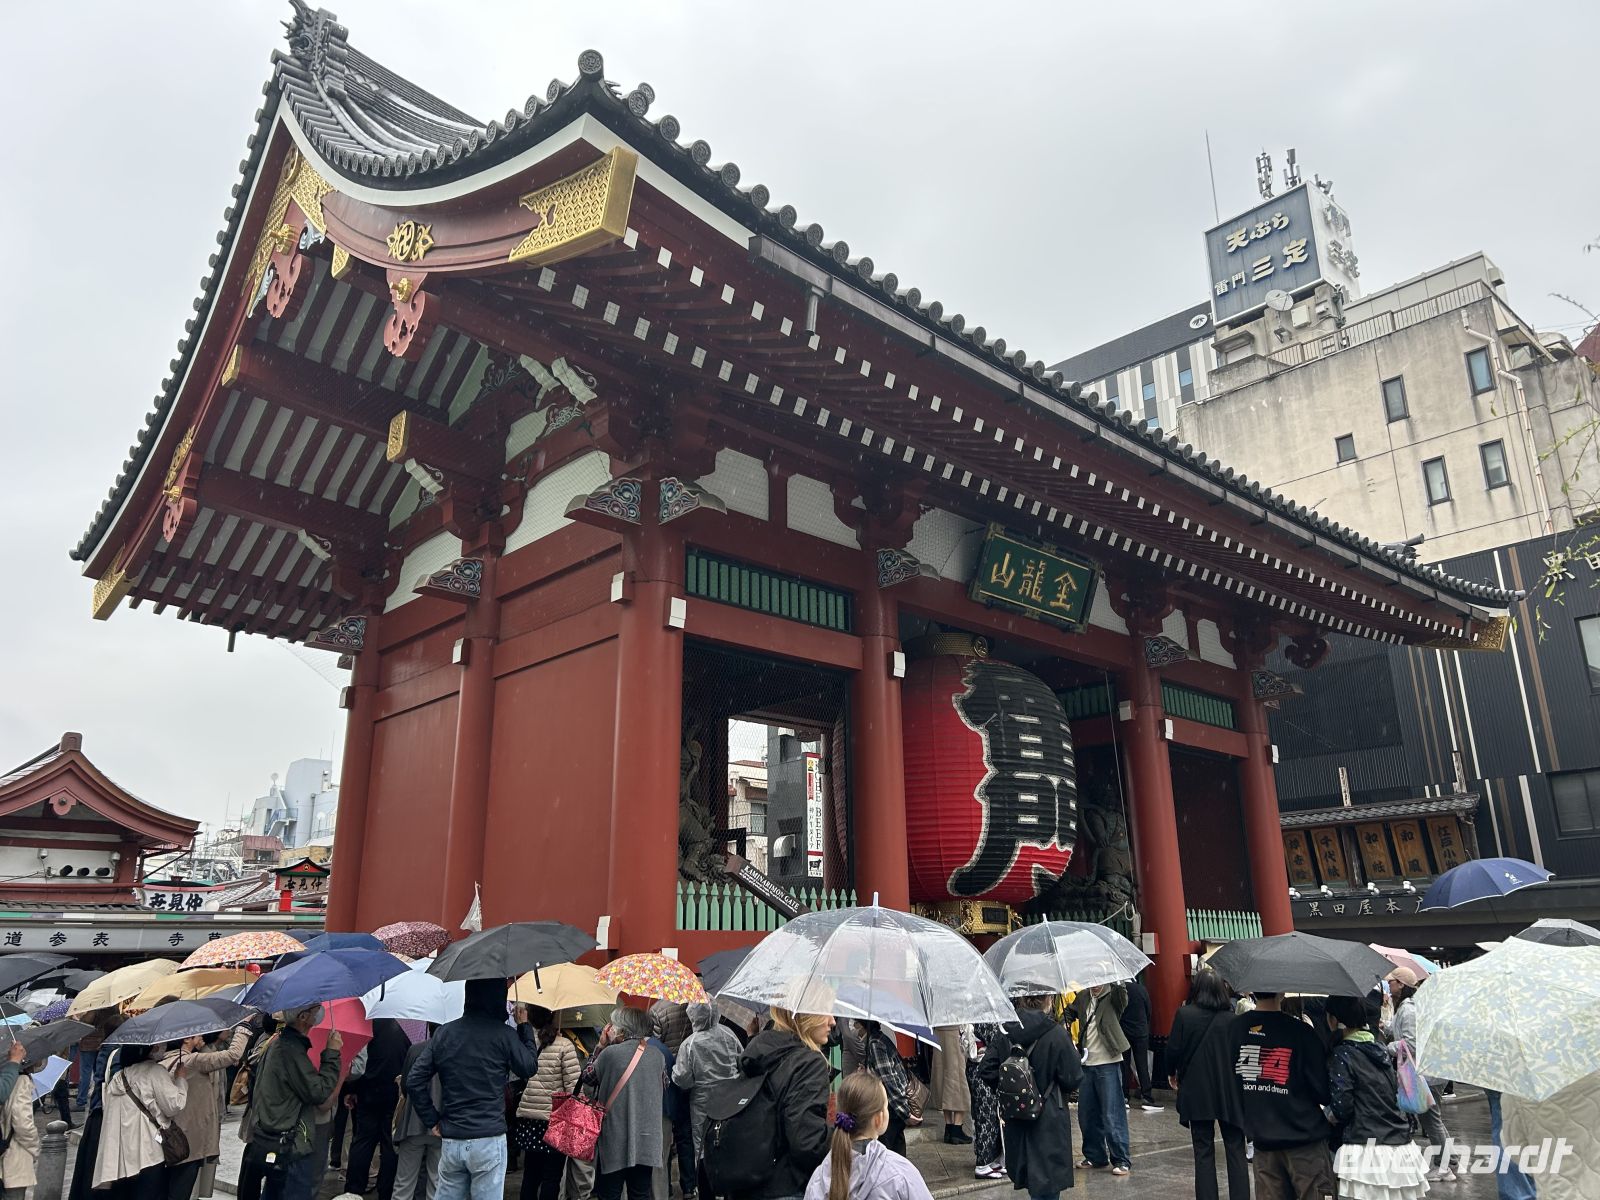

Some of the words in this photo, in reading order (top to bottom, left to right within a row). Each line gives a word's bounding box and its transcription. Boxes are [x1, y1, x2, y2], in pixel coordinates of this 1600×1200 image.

[1226, 212, 1290, 253] 天ぷら
[1214, 271, 1247, 296] 雷門
[1251, 237, 1309, 282] 三定
[744, 865, 786, 898] KAMINARIMON
[784, 895, 800, 910] GATE
[1257, 1084, 1271, 1092] and
